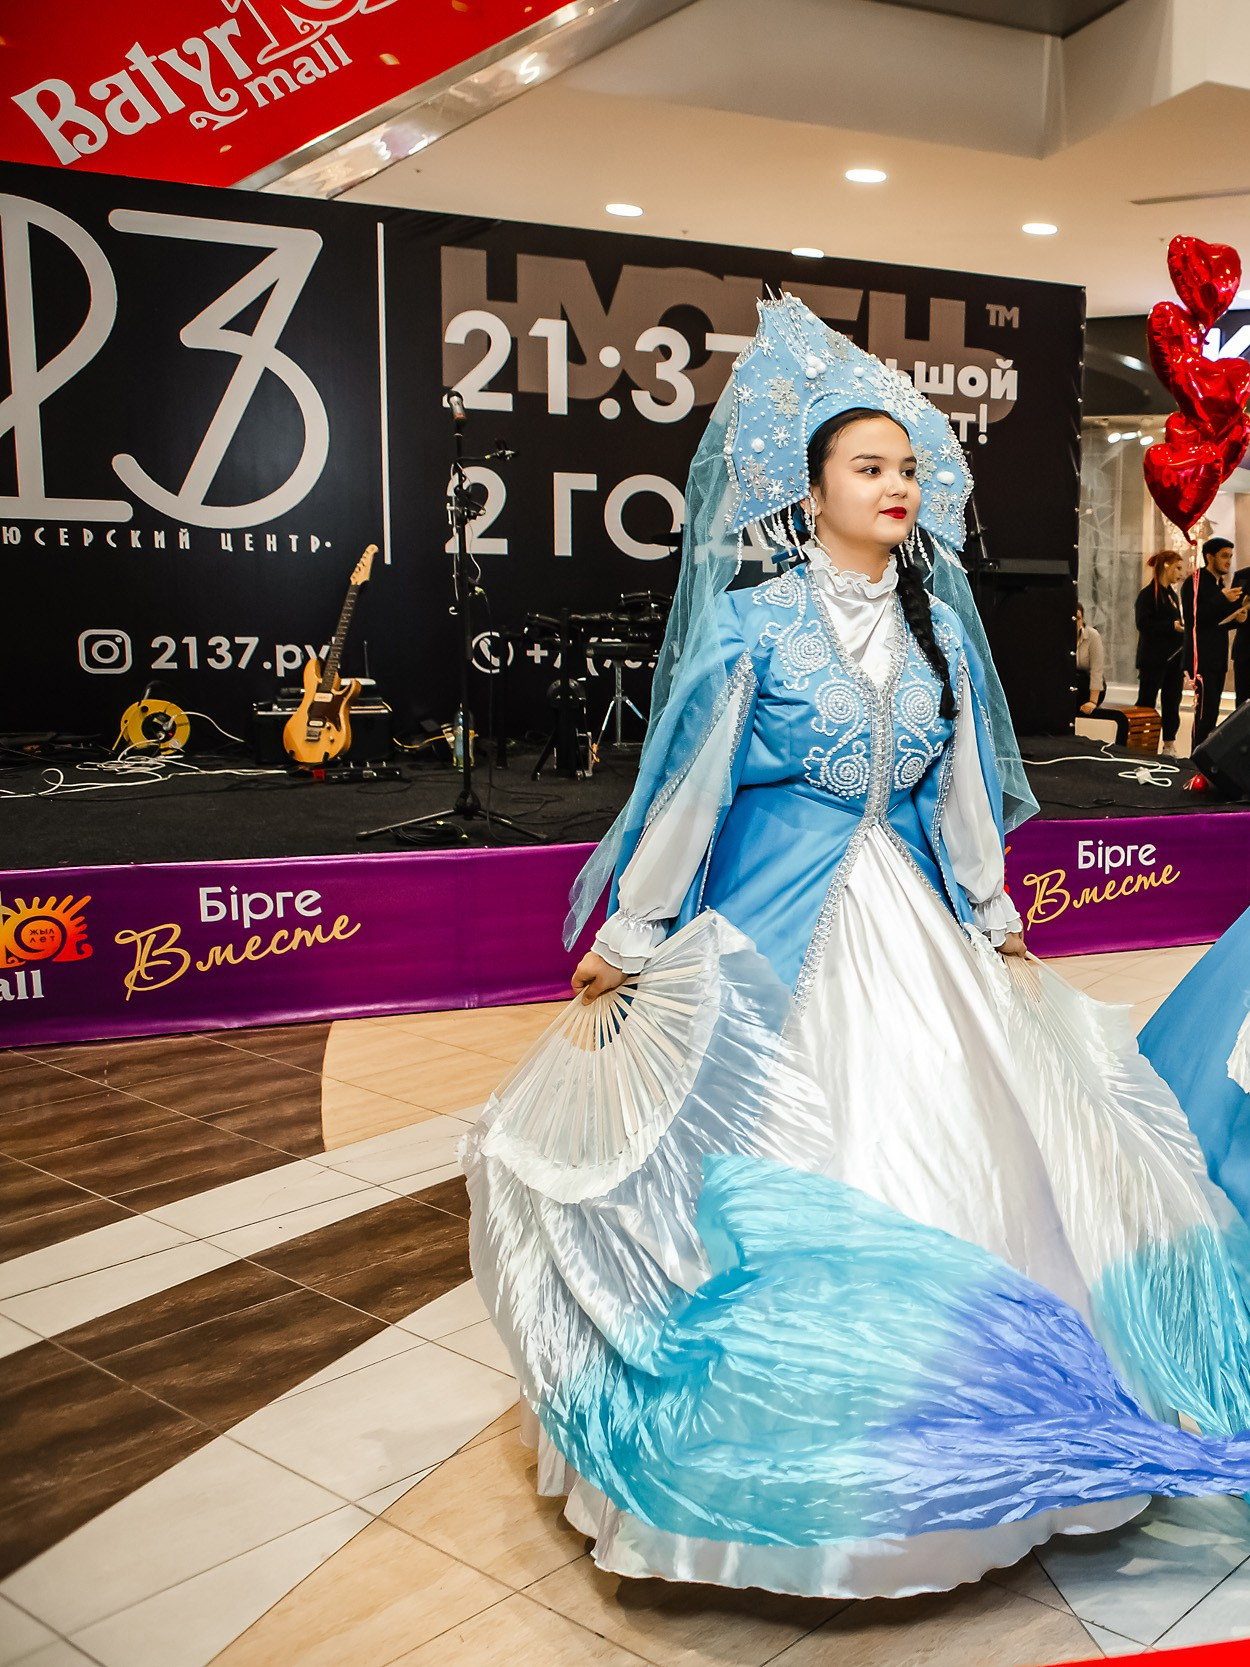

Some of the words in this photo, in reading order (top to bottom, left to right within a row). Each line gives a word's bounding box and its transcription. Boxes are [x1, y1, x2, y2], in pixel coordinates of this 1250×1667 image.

[11, 19, 252, 165] Batyr
[241, 34, 352, 108] mall
[2, 526, 190, 549] ЮСЕРСКИЙ
[445, 466, 508, 555] 2
[1077, 839, 1157, 875] Бірге
[199, 886, 322, 928] Бірге
[1023, 864, 1181, 931] Вместе
[0, 969, 45, 1001] all
[115, 914, 361, 1001] Вместе
